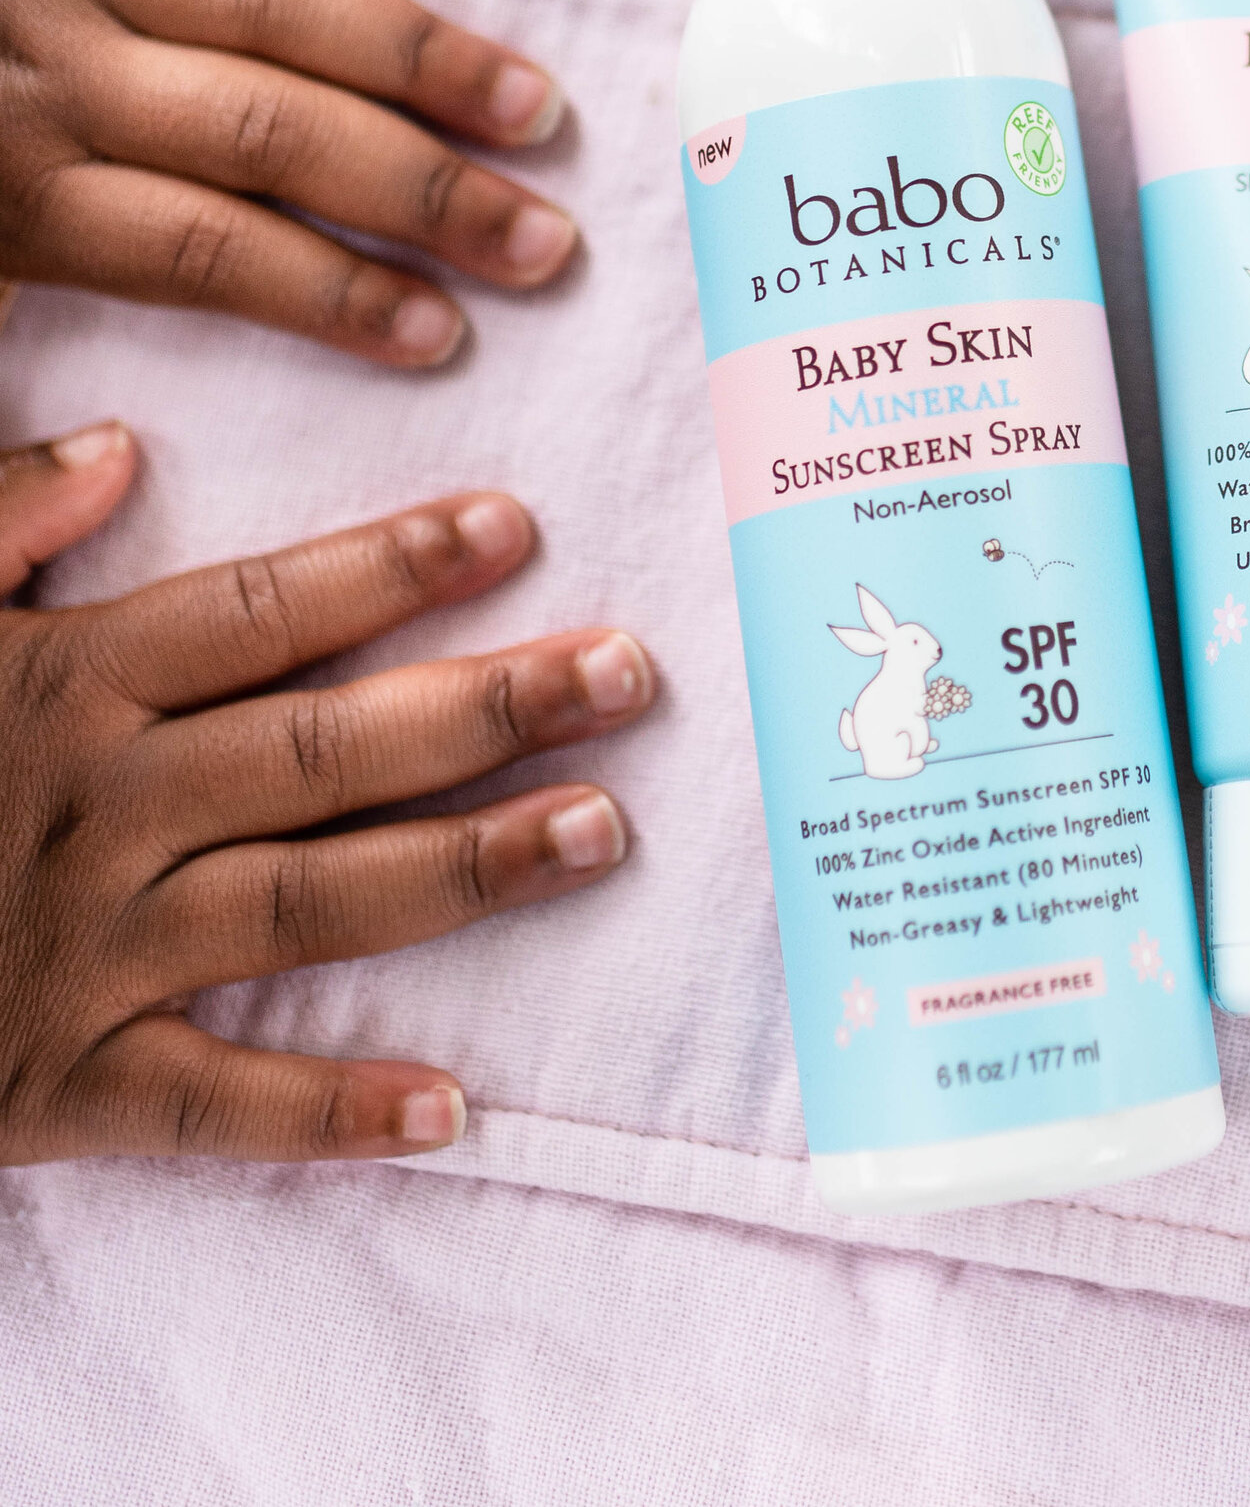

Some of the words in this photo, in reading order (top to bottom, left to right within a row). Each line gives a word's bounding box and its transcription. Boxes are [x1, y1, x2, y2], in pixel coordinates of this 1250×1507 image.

[1012, 107, 1053, 133] REEF
[697, 136, 732, 169] new
[1013, 153, 1062, 189] FRIENDLY
[784, 156, 1005, 246] babo
[792, 338, 907, 392] BABY
[926, 322, 1033, 367] SKIN
[827, 379, 1020, 435] MINERAL
[772, 434, 972, 494] SUNSCREEN
[988, 422, 1081, 456] SPRAY
[853, 481, 1011, 523] Non-Aerosol
[1001, 621, 1078, 675] SPF
[1021, 678, 1079, 730] 30
[800, 813, 849, 840] Broad
[856, 796, 966, 834] Spectrum
[977, 775, 1093, 810] Sunscreen
[1098, 768, 1130, 789] SPF
[1135, 765, 1151, 786] 30
[815, 849, 856, 876] 100%
[862, 846, 904, 869] Zinc
[914, 833, 979, 860] Oxide
[988, 821, 1057, 849] Active
[1064, 807, 1150, 843] Ingredient
[832, 886, 895, 913] Water
[902, 868, 1010, 903] Resistant
[1018, 860, 1054, 888] (80
[1062, 844, 1143, 879] Minutes)
[849, 914, 981, 950] Non-Greasy
[992, 908, 1008, 927] &
[1017, 886, 1139, 925] Lightweight
[921, 979, 1045, 1017] FRAGRANCE
[1050, 972, 1094, 993] FREE
[936, 1066, 951, 1089] 6
[957, 1061, 971, 1085] fl
[978, 1057, 1005, 1083] oz
[1010, 1052, 1019, 1078] /
[1024, 1047, 1065, 1073] 177
[1073, 1040, 1099, 1066] ml
